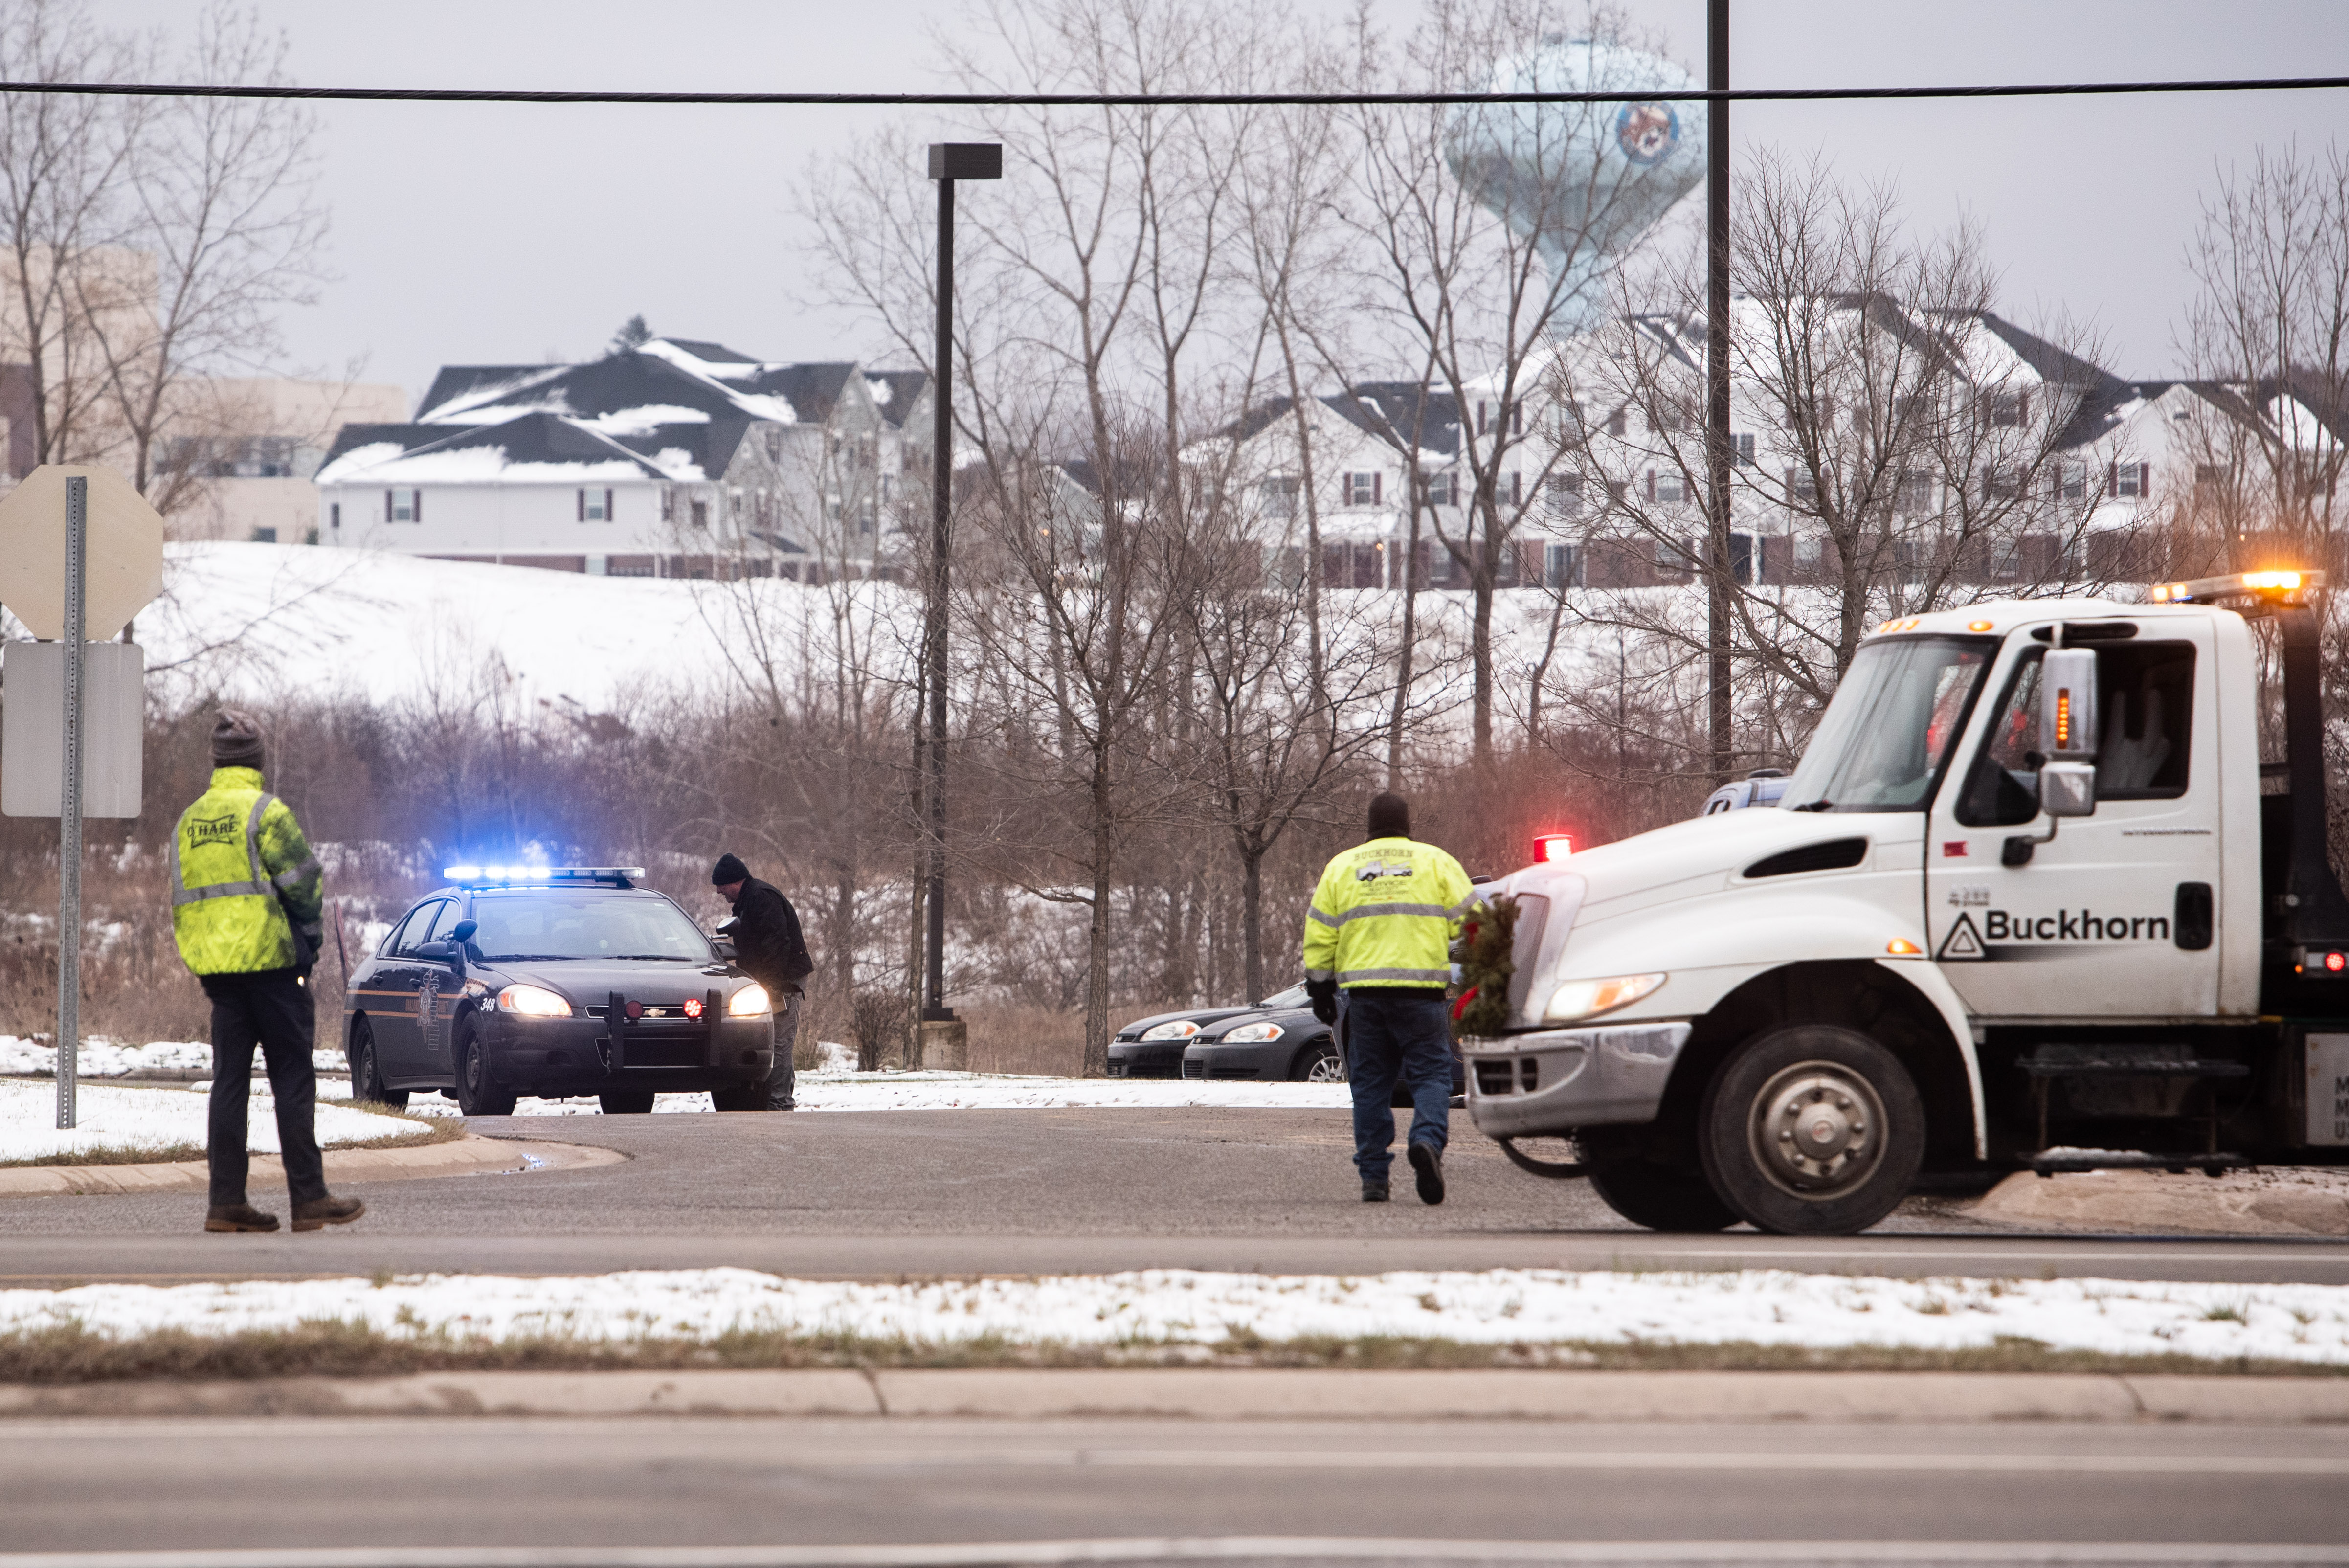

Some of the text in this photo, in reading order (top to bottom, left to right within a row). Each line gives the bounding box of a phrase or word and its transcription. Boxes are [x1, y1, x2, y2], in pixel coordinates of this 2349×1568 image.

[1354, 849, 1413, 861] BUCKHORN
[1986, 909, 2169, 939] Buckhorn
[480, 998, 495, 1011] 348
